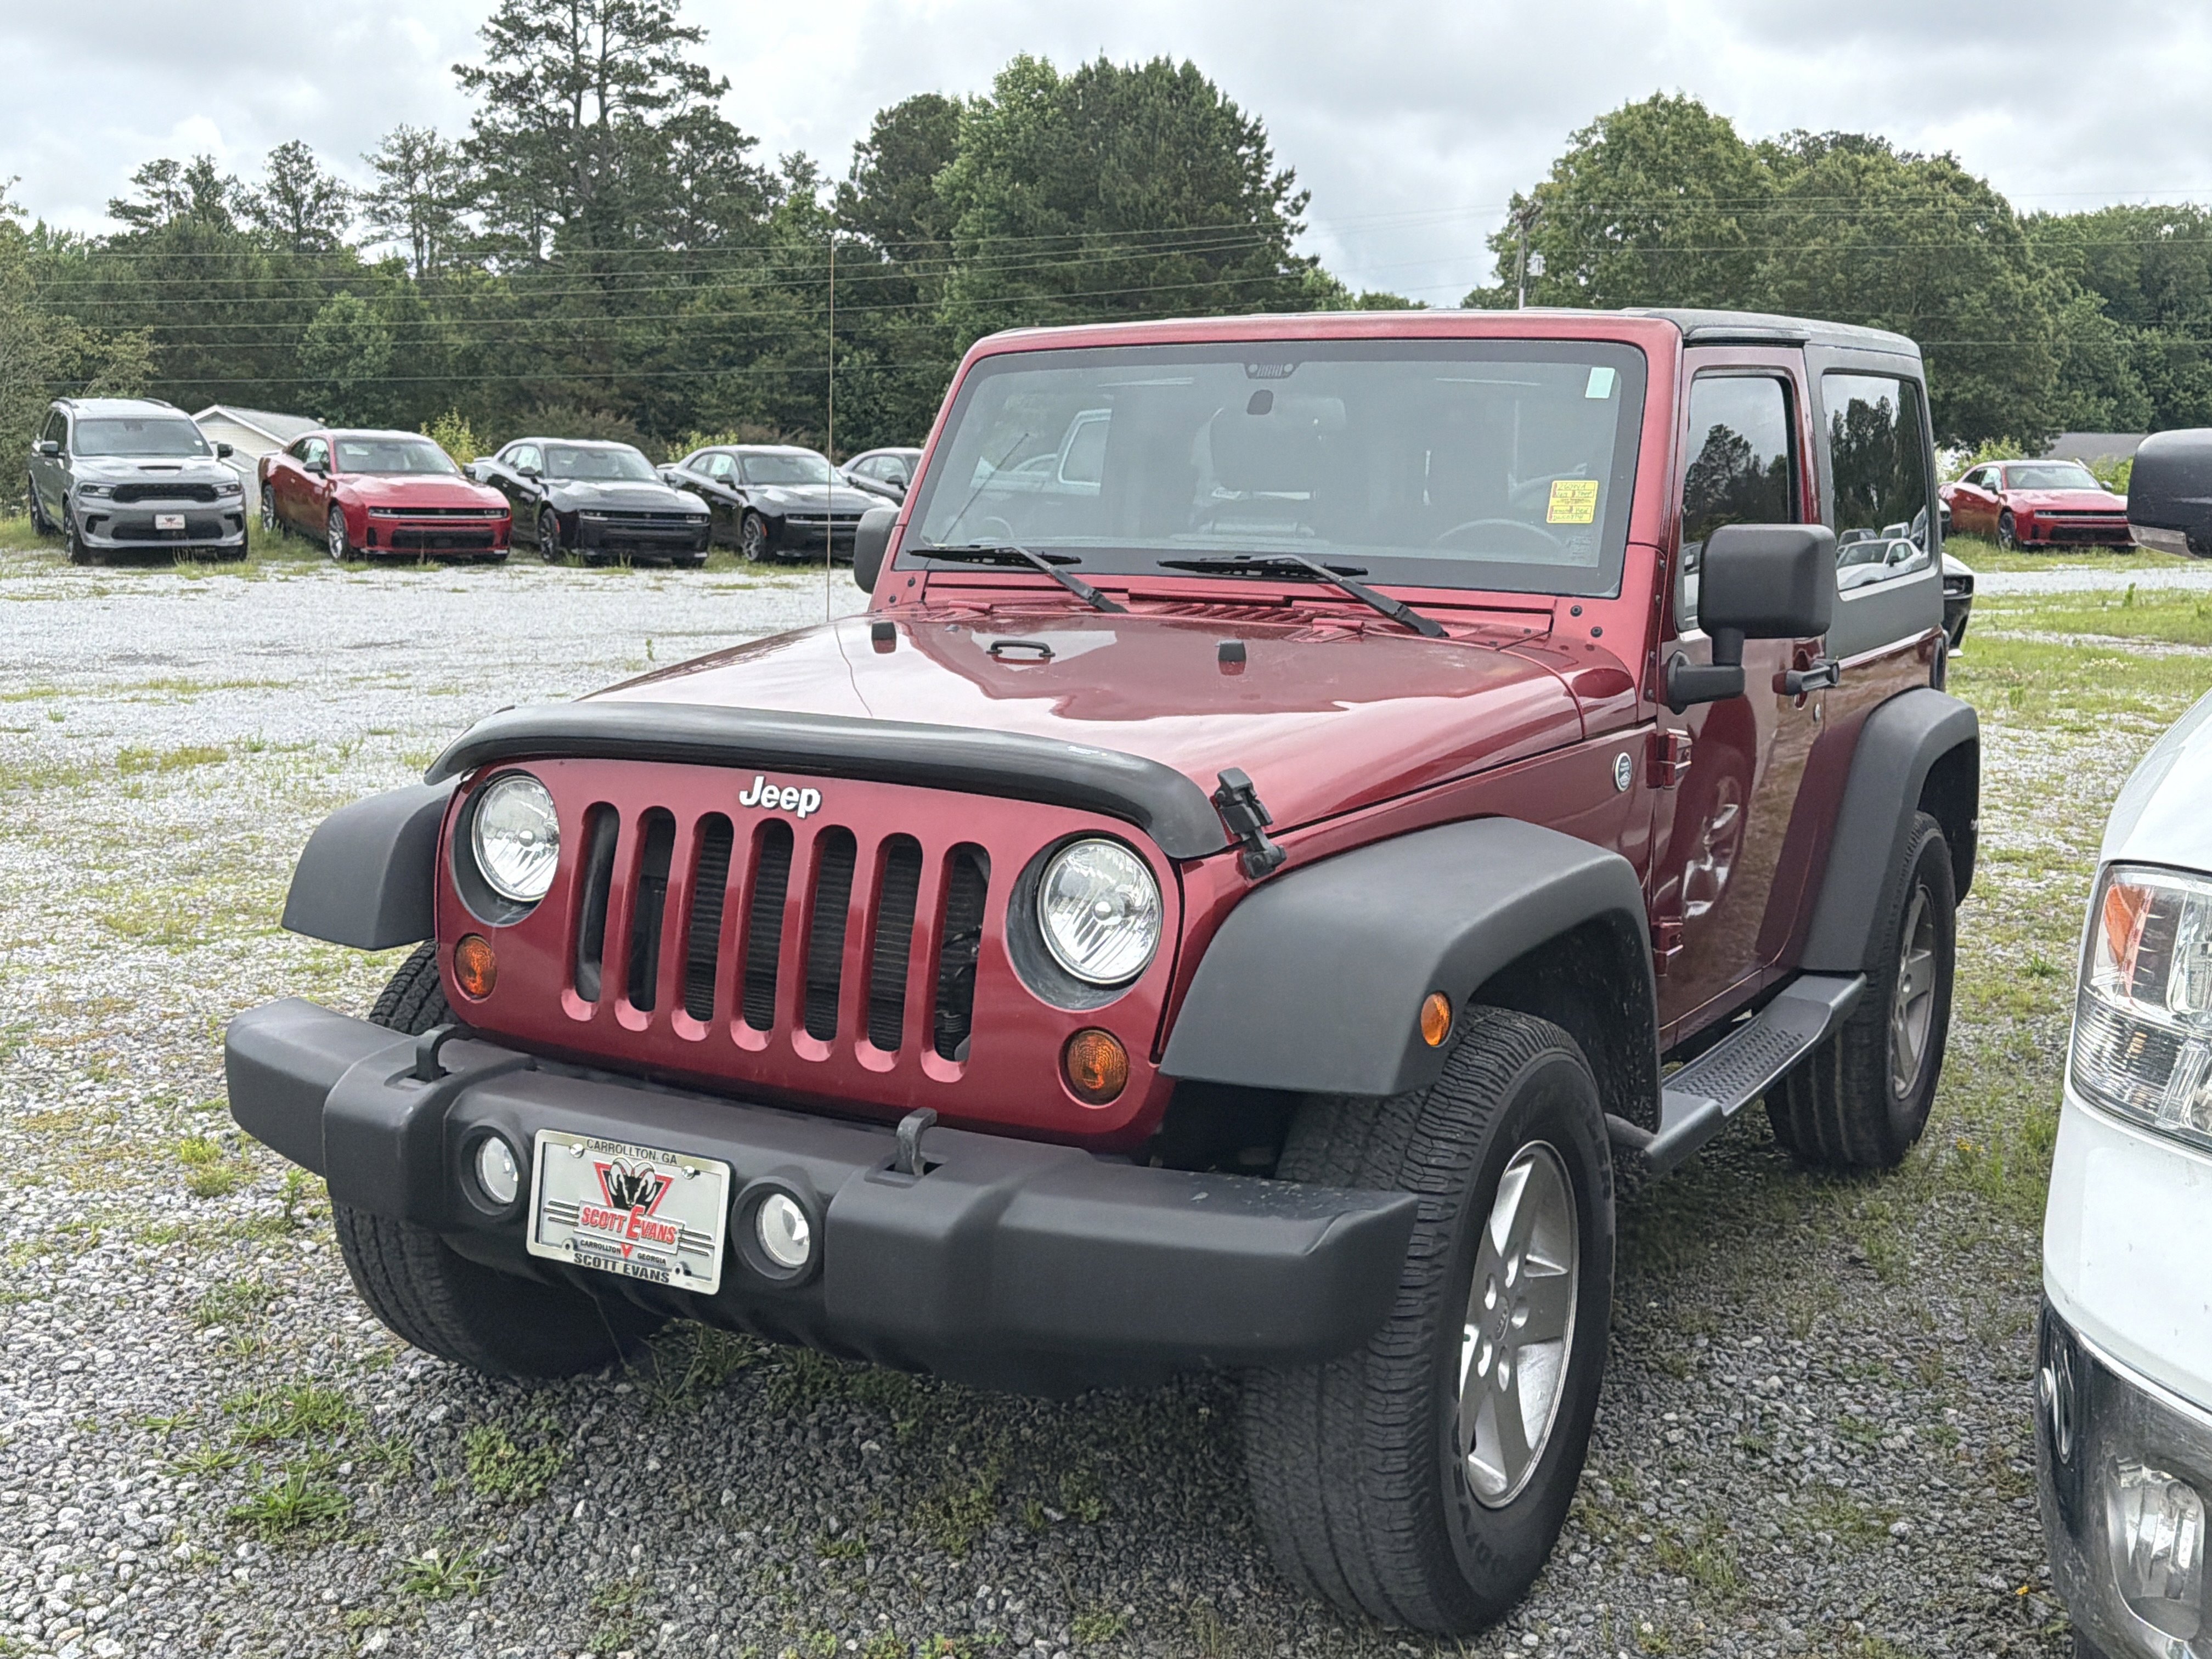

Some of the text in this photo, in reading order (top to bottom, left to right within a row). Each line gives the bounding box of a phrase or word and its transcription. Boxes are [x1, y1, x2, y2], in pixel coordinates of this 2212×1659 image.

[739, 776, 821, 819] Jeep
[662, 1153, 677, 1165] GA
[582, 1206, 627, 1233] SCOTT
[580, 1240, 667, 1266] CARROLLTON GEORGIA
[573, 1253, 670, 1283] SCOTT EVANS
